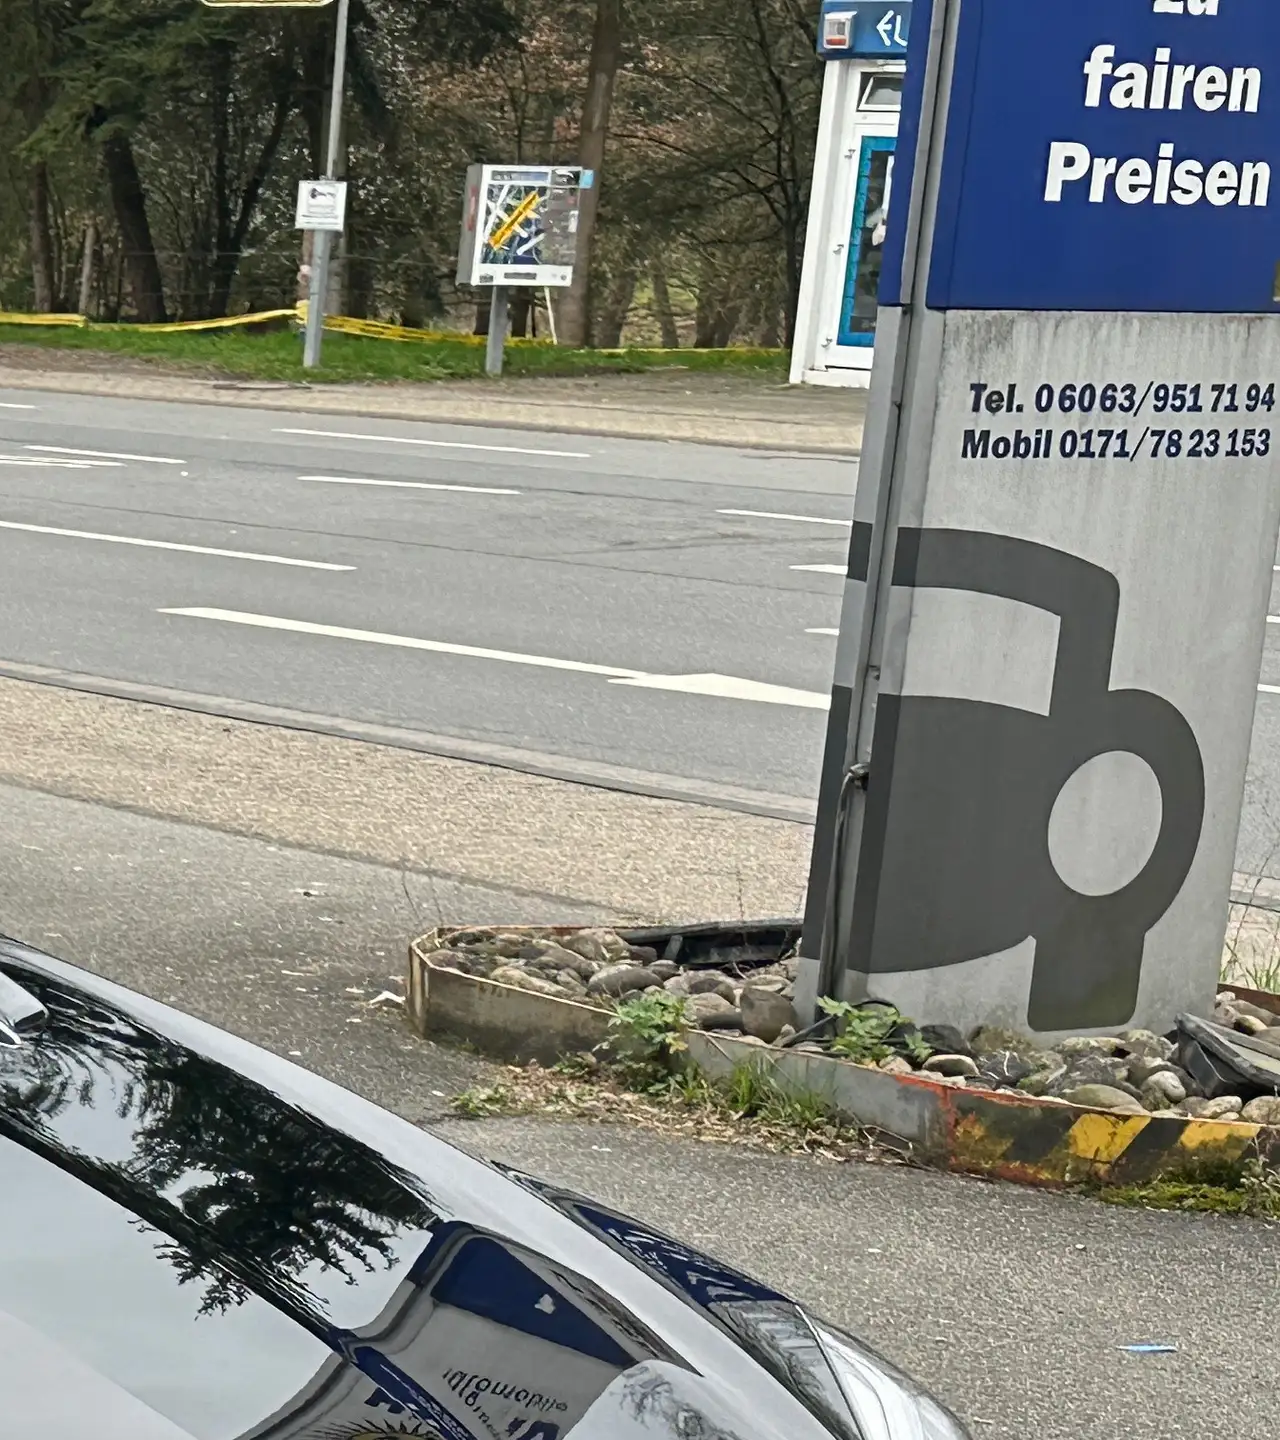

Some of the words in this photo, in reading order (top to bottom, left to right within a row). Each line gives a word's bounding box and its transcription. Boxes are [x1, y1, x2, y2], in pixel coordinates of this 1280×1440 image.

[1083, 44, 1261, 113] fairen
[1044, 141, 1271, 206] Preisen
[969, 383, 1024, 415] Tel.
[961, 428, 1053, 459] Mobil
